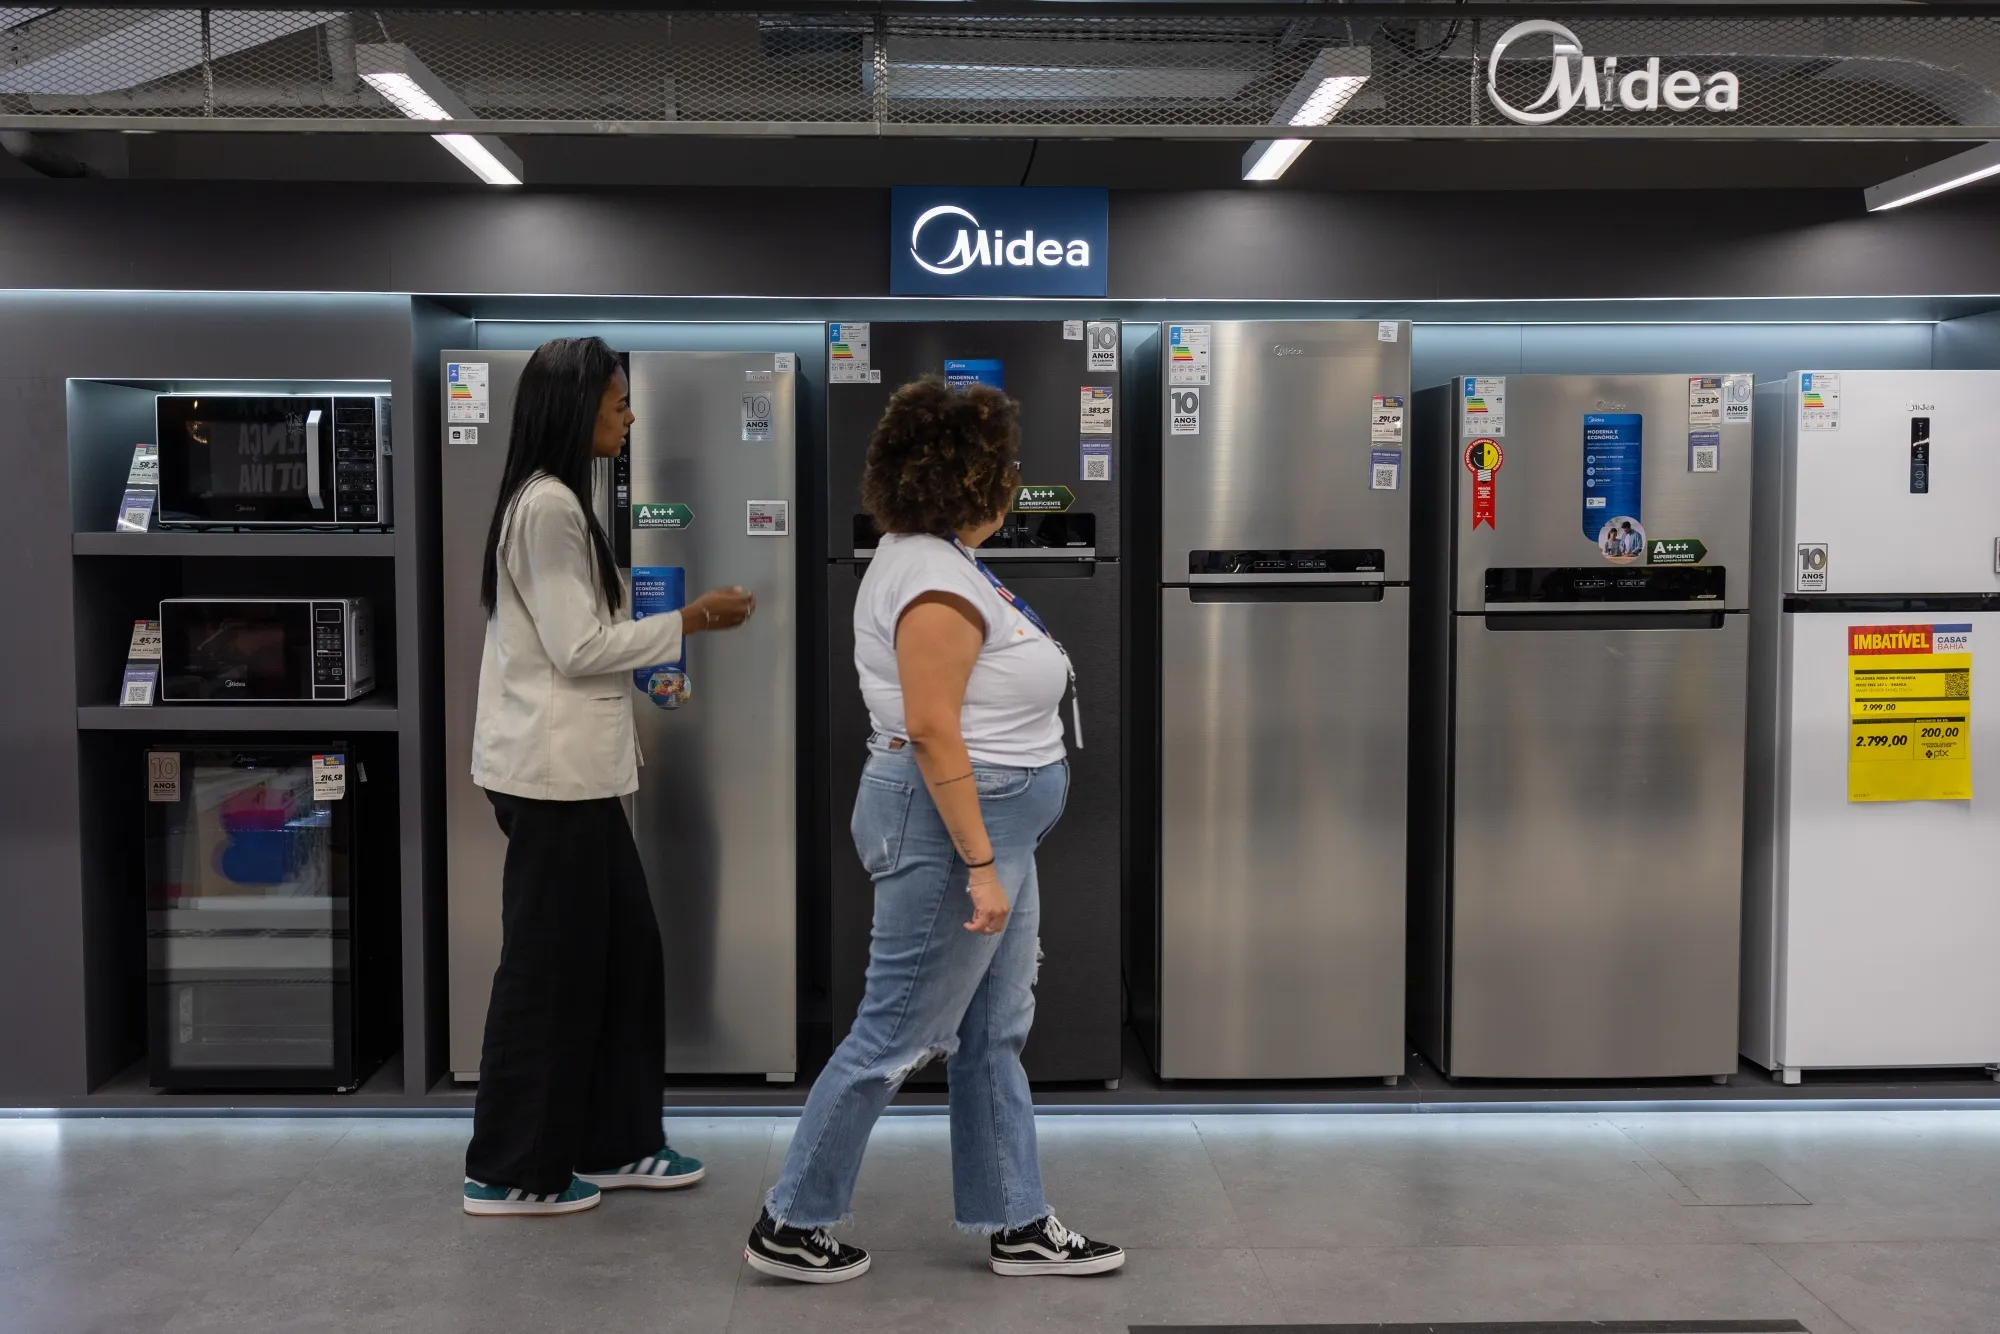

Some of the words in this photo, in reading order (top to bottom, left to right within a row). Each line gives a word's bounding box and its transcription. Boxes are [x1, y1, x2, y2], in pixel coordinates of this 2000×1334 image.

[1486, 20, 1739, 125] Midea
[911, 205, 1089, 275] Midea
[1088, 326, 1117, 350] 10
[1722, 379, 1751, 403] 10
[742, 395, 771, 419] 10
[1171, 391, 1199, 414] 10
[1696, 397, 1720, 405] 333,25
[1587, 416, 1606, 424] Midea
[1019, 488, 1055, 501] A+++
[638, 505, 676, 518] A+++
[1653, 541, 1689, 554] A+++
[1799, 547, 1827, 571] 10
[1853, 629, 1930, 650] IMBATÍVEL
[1937, 636, 1968, 644] CASAS
[1937, 643, 1965, 651] BAHIA
[225, 679, 246, 689] Midea
[1863, 703, 1896, 712] 2.999,00
[1921, 727, 1959, 739] 200,00
[1856, 735, 1908, 748] 2.799,00
[151, 757, 179, 780] 10
[320, 773, 343, 782] 216,58
